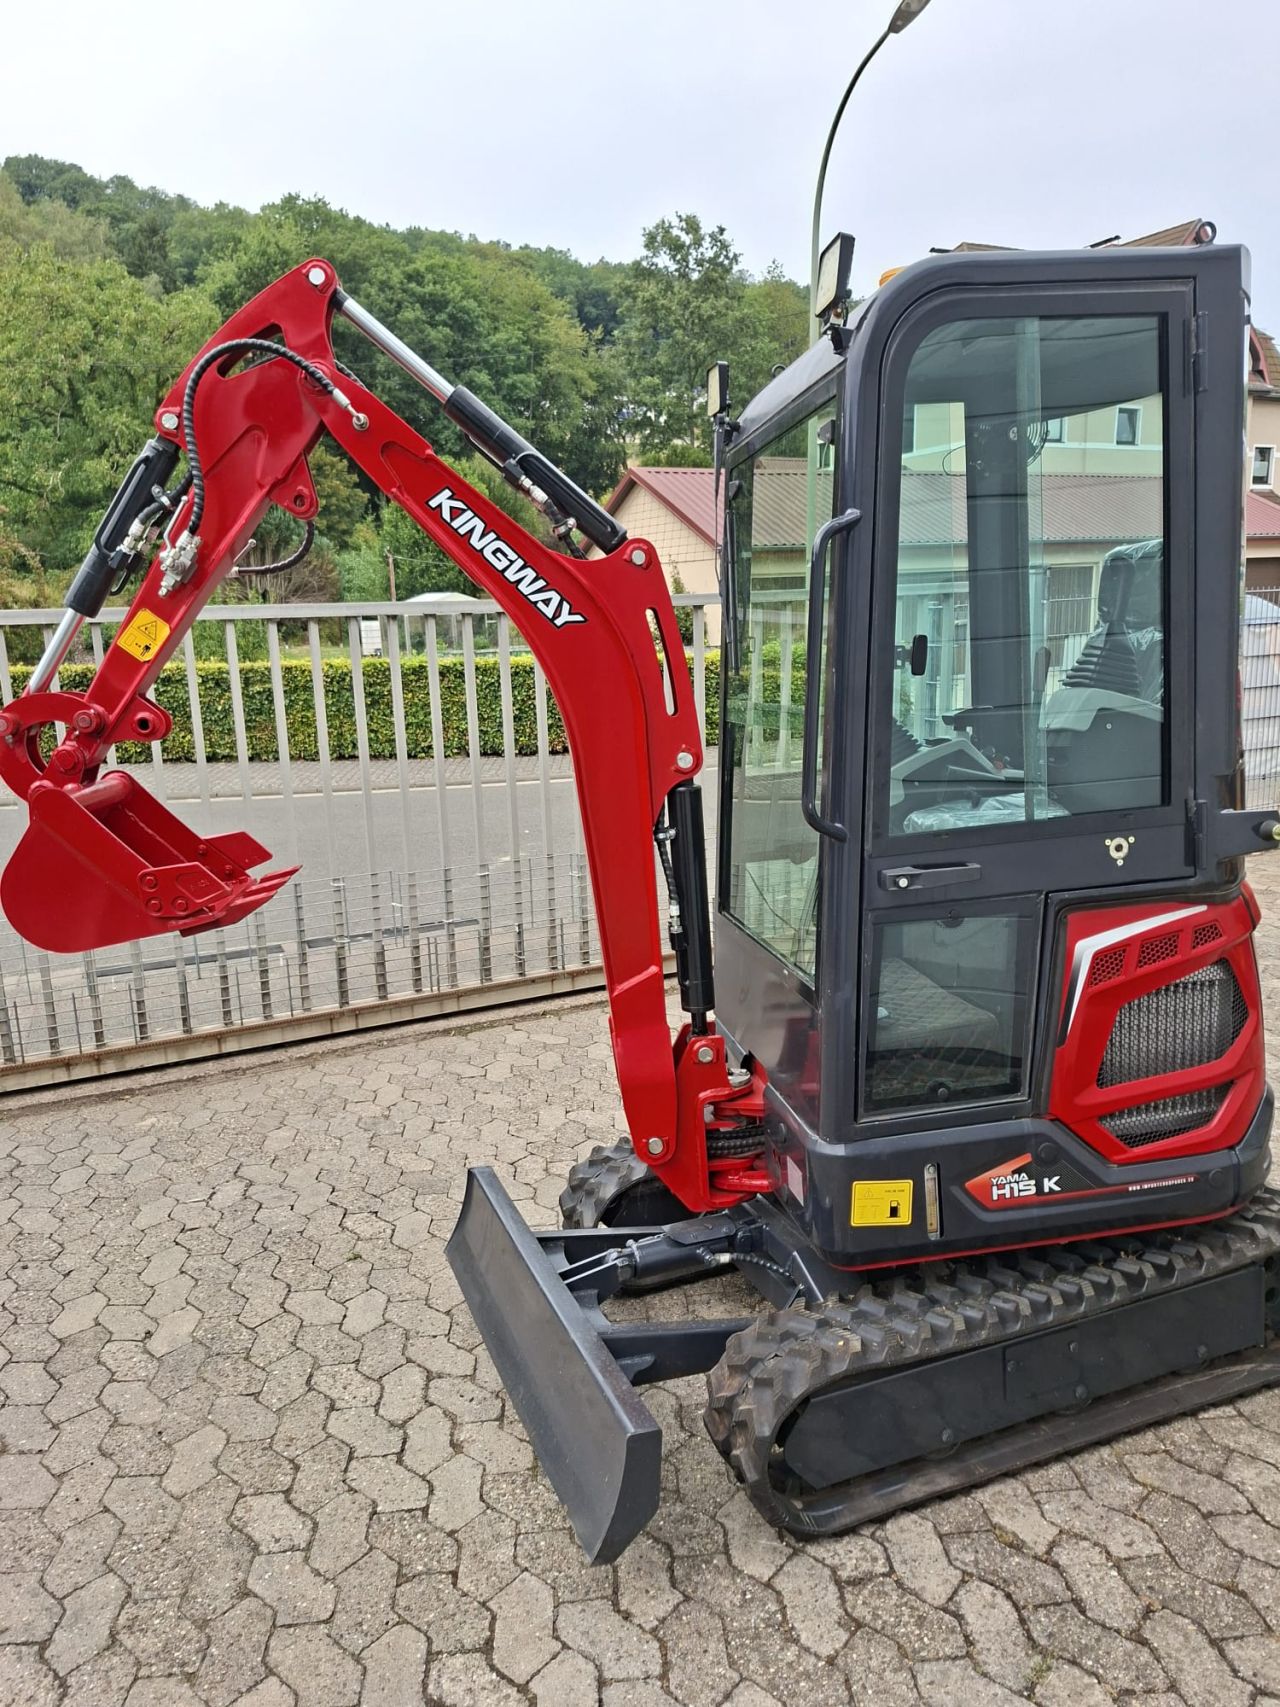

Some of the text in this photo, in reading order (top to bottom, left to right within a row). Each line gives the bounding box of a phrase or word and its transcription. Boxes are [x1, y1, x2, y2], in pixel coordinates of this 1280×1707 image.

[427, 487, 587, 628] KINGWAY
[991, 1172, 1029, 1185] YAMA
[992, 1175, 1062, 1201] H15 K
